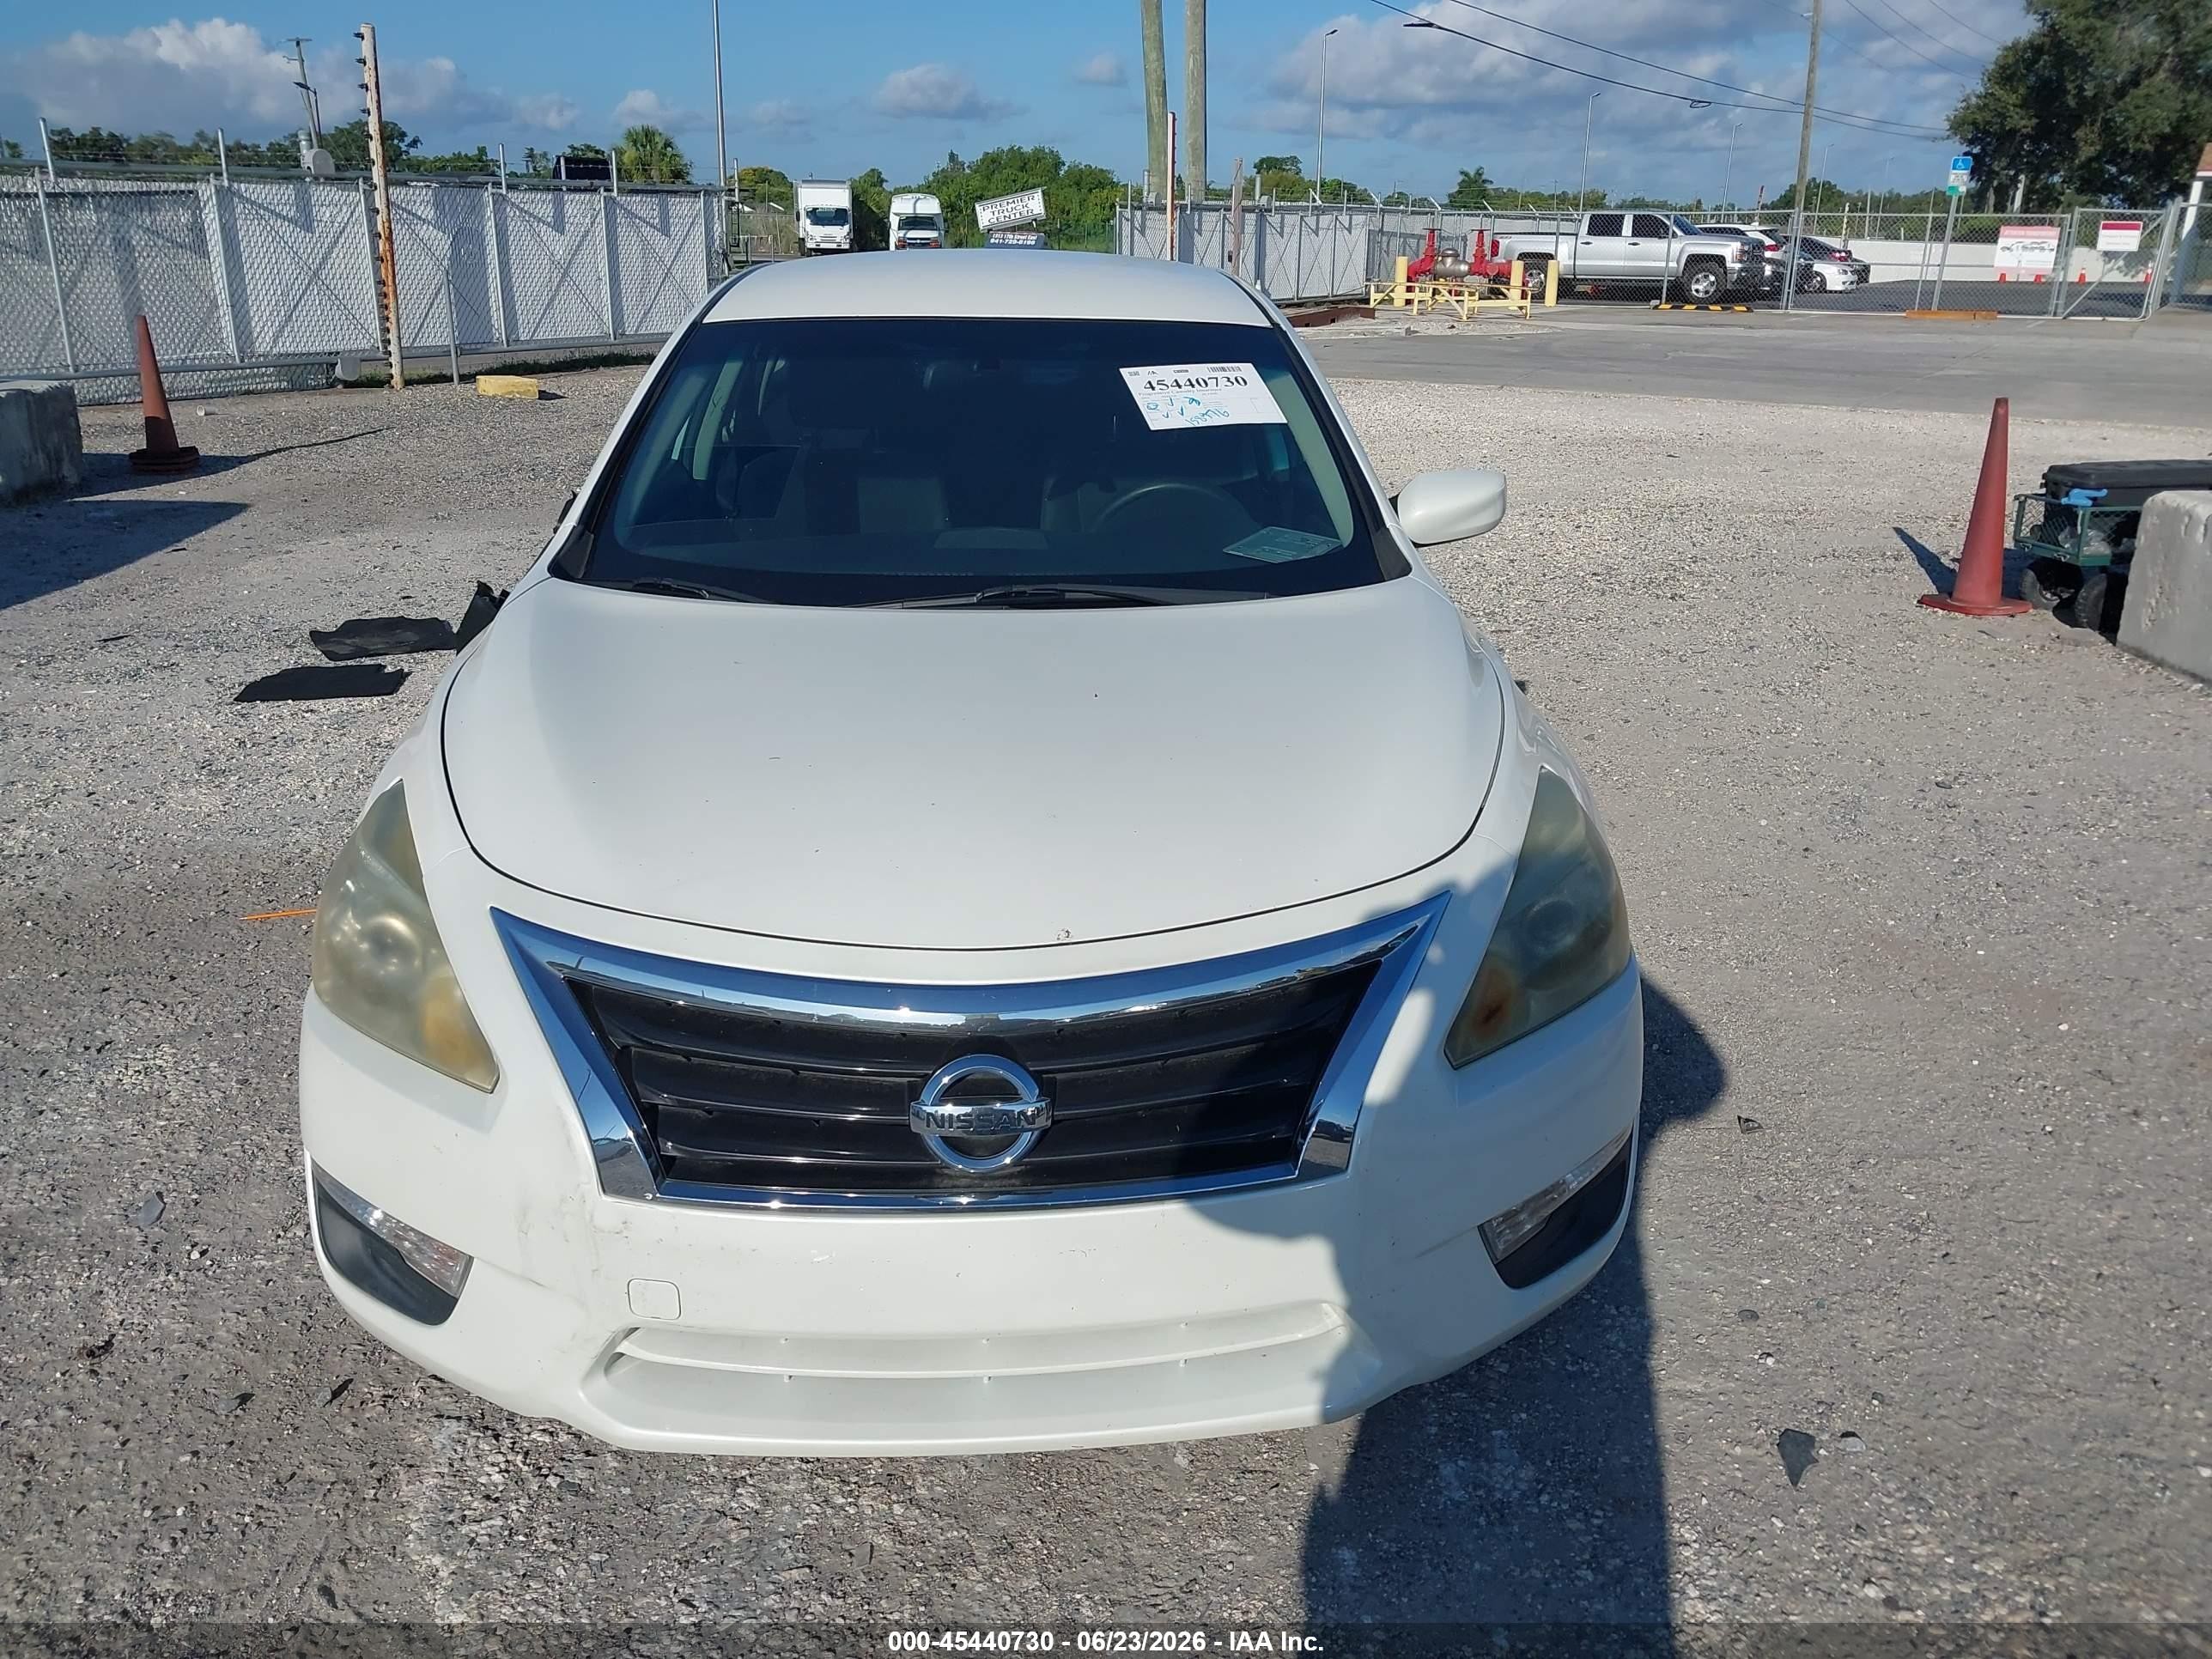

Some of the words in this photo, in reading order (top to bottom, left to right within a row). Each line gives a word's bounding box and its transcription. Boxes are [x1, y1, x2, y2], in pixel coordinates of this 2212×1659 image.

[982, 195, 1036, 212] PREMIER
[989, 203, 1030, 216] TRUCK
[988, 209, 1034, 223] CENTER
[1143, 375, 1249, 392] 45440730
[925, 1109, 1036, 1131] NISSAN
